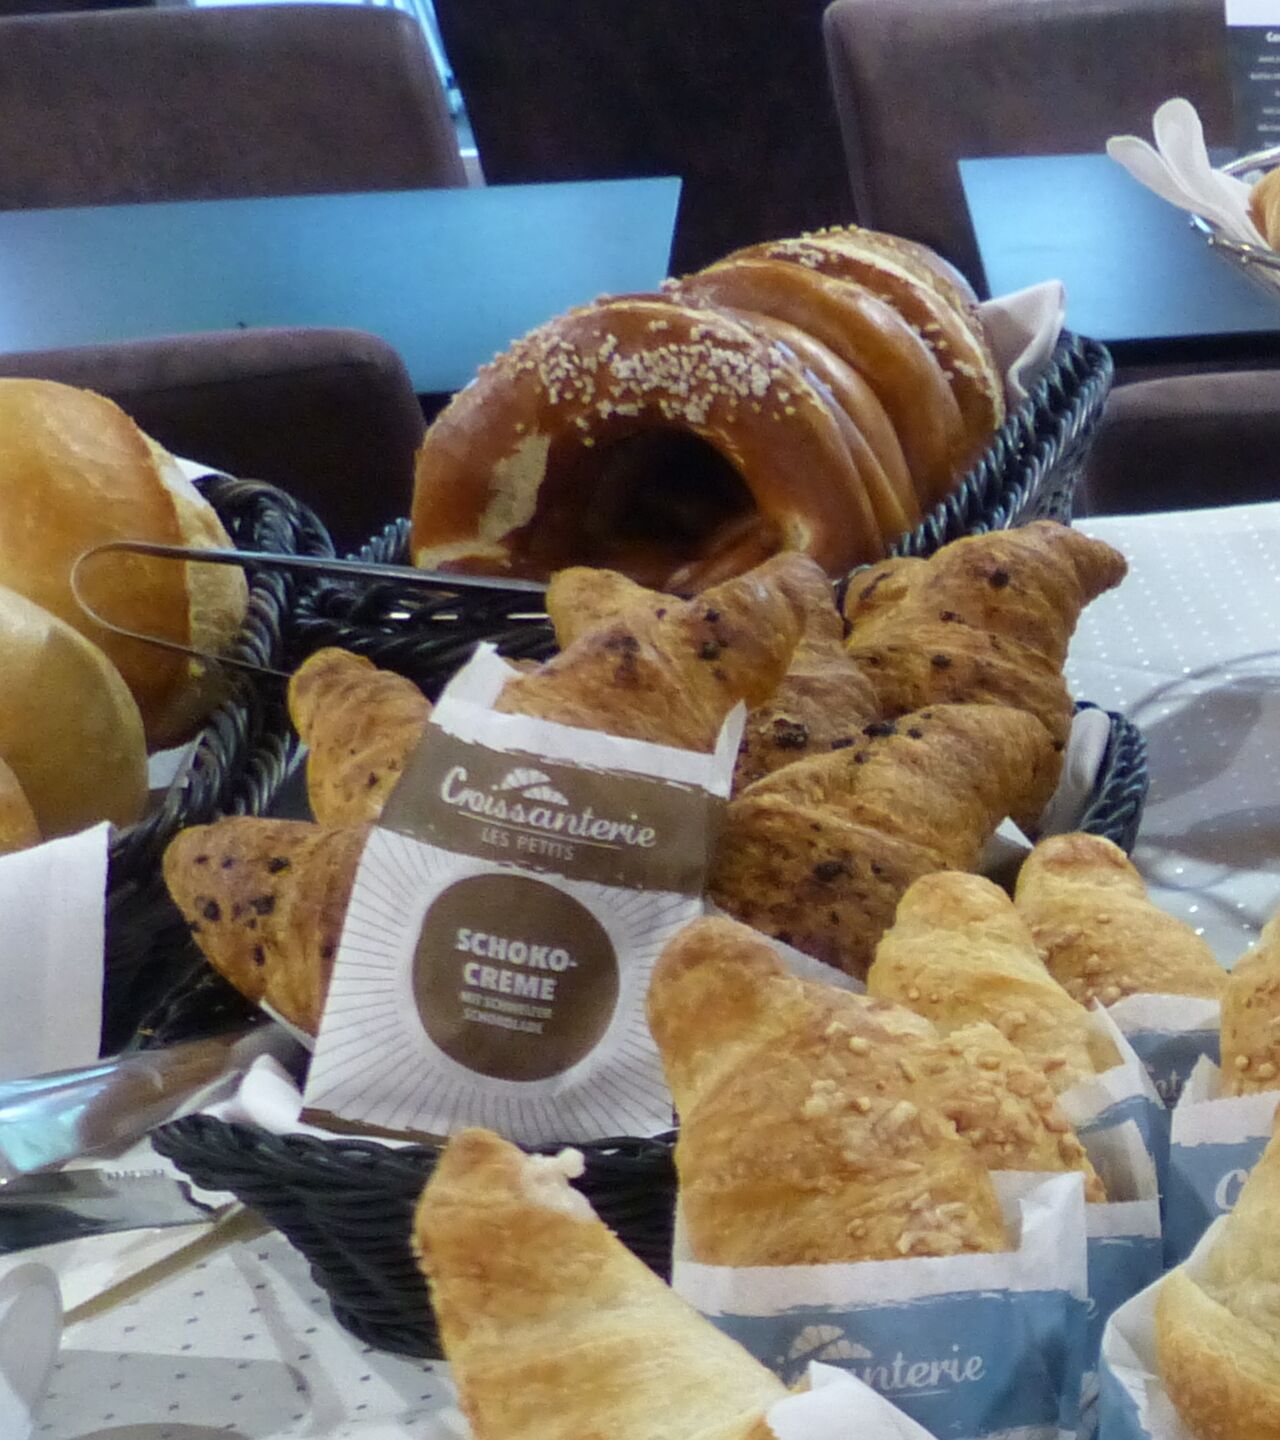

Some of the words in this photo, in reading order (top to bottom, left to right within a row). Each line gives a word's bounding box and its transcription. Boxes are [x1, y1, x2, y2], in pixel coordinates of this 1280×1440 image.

[440, 765, 657, 848] Croissanterie
[481, 827, 510, 848] LES
[516, 834, 575, 861] PETITS
[455, 928, 578, 972] SCHOKO-
[464, 962, 558, 1001] CREME
